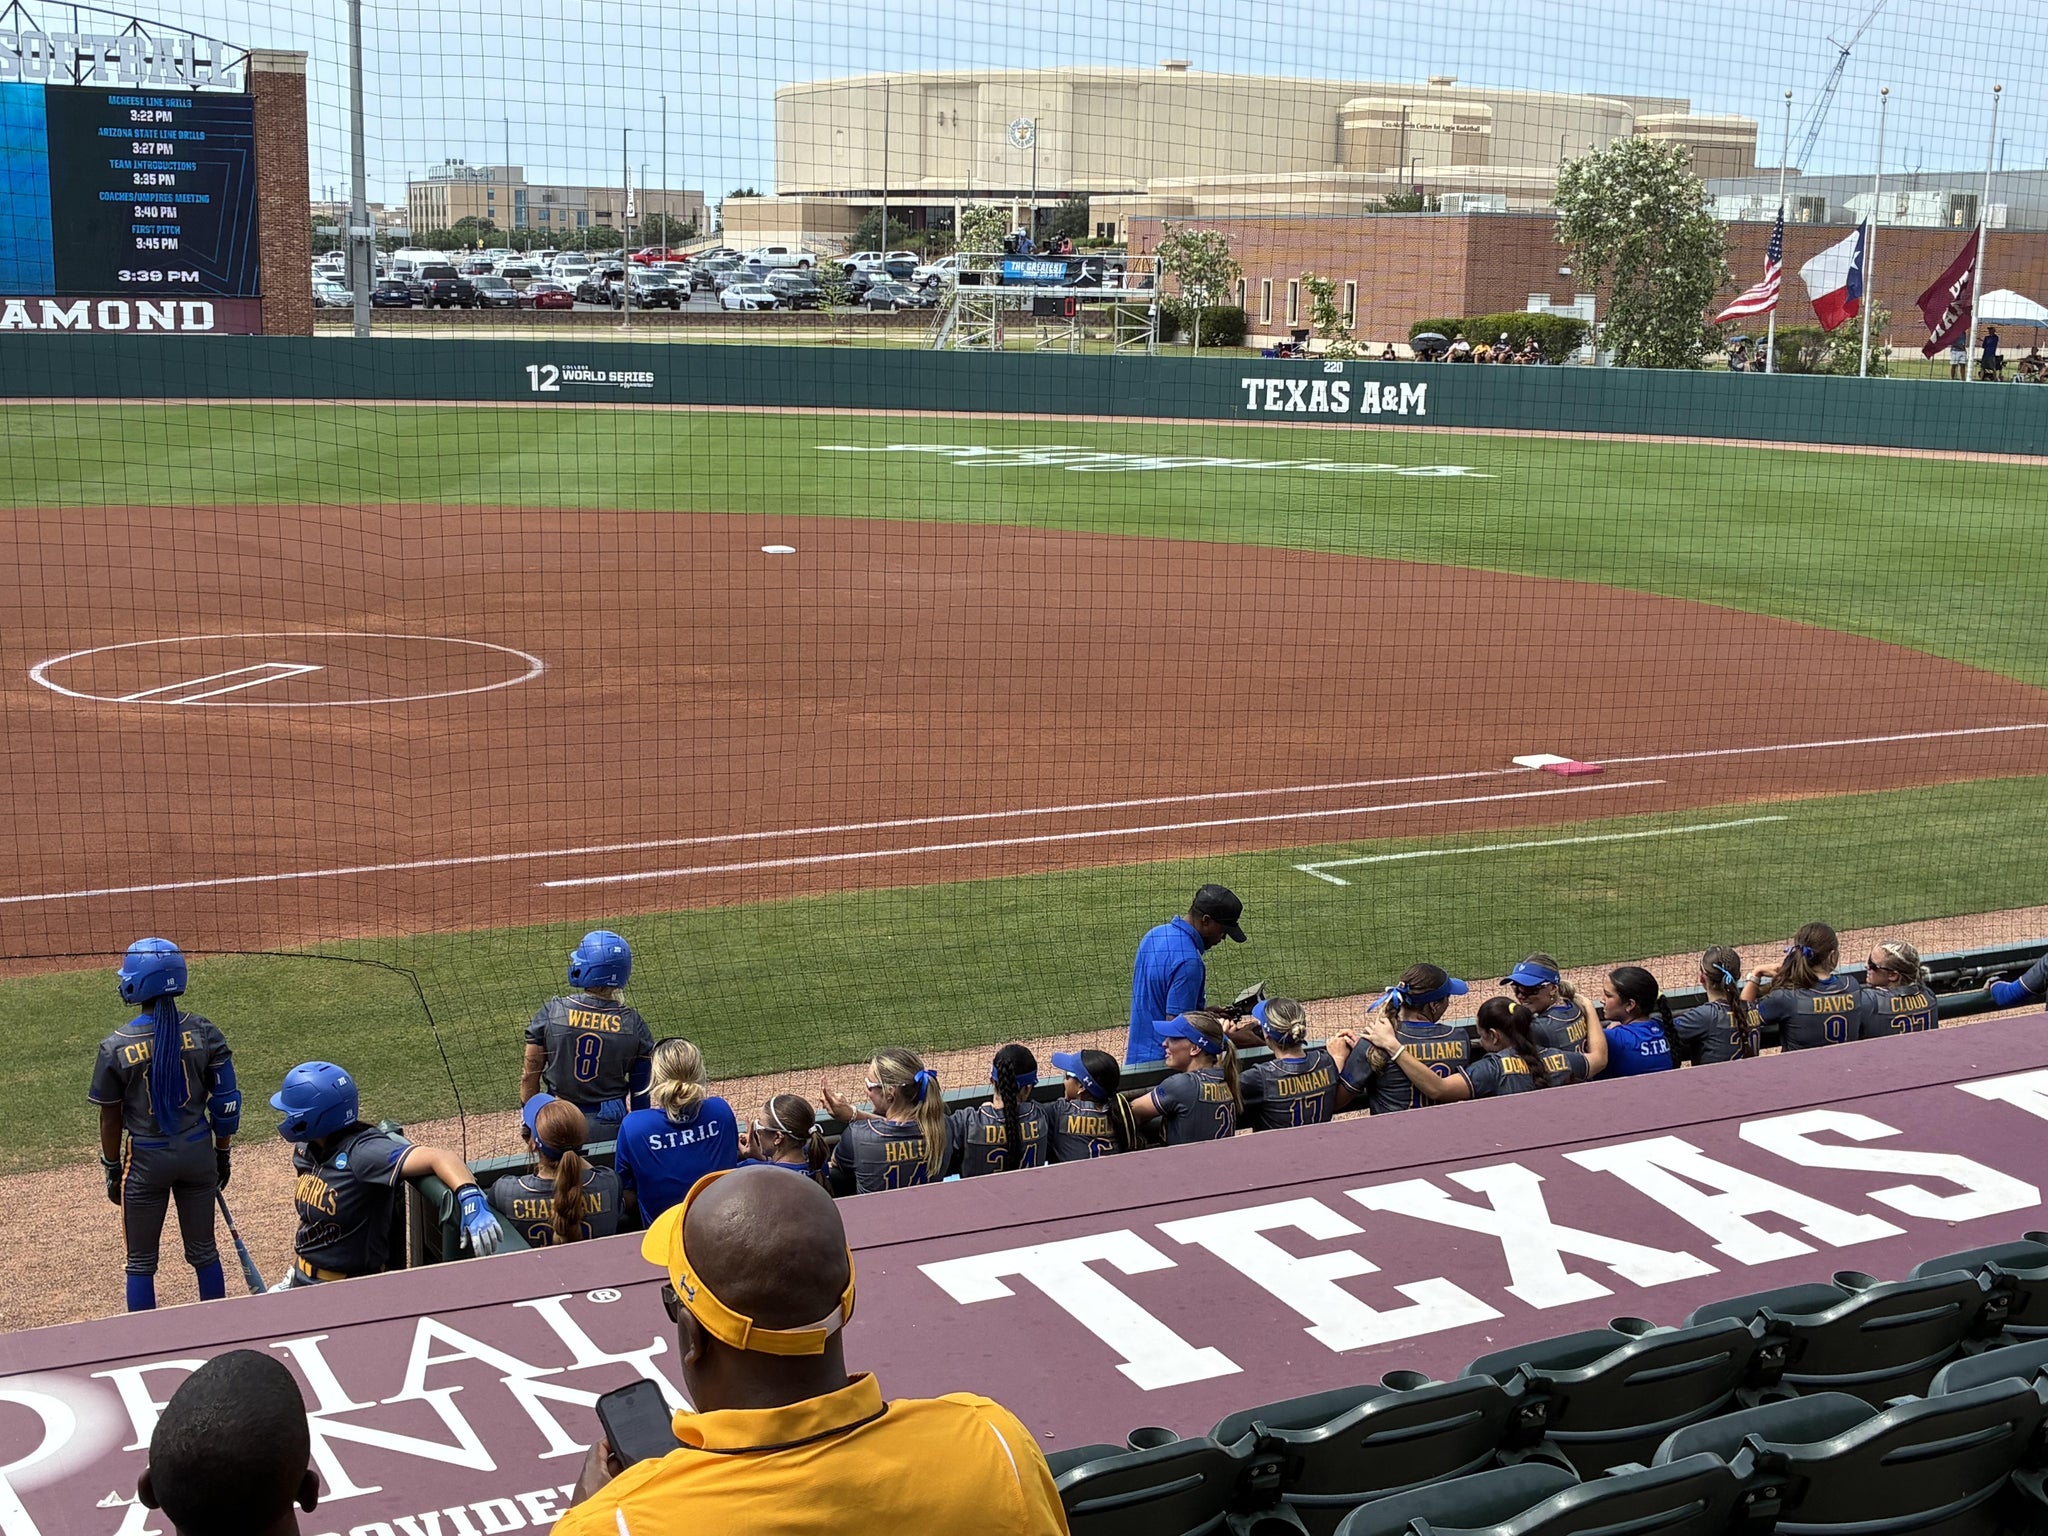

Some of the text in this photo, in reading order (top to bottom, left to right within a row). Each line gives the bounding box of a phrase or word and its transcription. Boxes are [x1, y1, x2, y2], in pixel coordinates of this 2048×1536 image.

[0, 29, 237, 88] SOFTBALL
[146, 97, 164, 107] LINE
[165, 98, 193, 108] DRILLS
[130, 109, 173, 123] 3:22 PM
[98, 127, 206, 140] ARIZONA STATE LINE DRILLS
[132, 142, 174, 155] 3:27 PM
[109, 159, 197, 171] TEAM INTRODUCTIONS
[133, 173, 175, 186] 3:35 PM
[175, 193, 210, 204] MEETING
[134, 206, 177, 219] 3:40 PM
[131, 224, 181, 235] FIRST PITCH
[136, 238, 179, 250] 3:45 PM
[1011, 261, 1062, 273] THE GREATEST
[118, 270, 200, 283] 3:39 PM
[1323, 361, 1344, 373] 220
[525, 364, 561, 392] 12
[562, 370, 655, 383] WORLD SERIES
[1241, 378, 1428, 416] TEXAS A&M
[1813, 994, 1855, 1013] DAVIS
[1890, 993, 1929, 1013] CLOUD
[567, 1008, 622, 1033] WEEKS
[1823, 1014, 1848, 1044] 9
[574, 1032, 603, 1083] 8
[1277, 1068, 1331, 1097] DUNHAM
[1289, 1091, 1326, 1127] 17
[649, 1120, 720, 1151] S.T.R.I.C
[513, 1192, 602, 1219] CHAAN
[917, 1108, 2042, 1391] TEXAS
